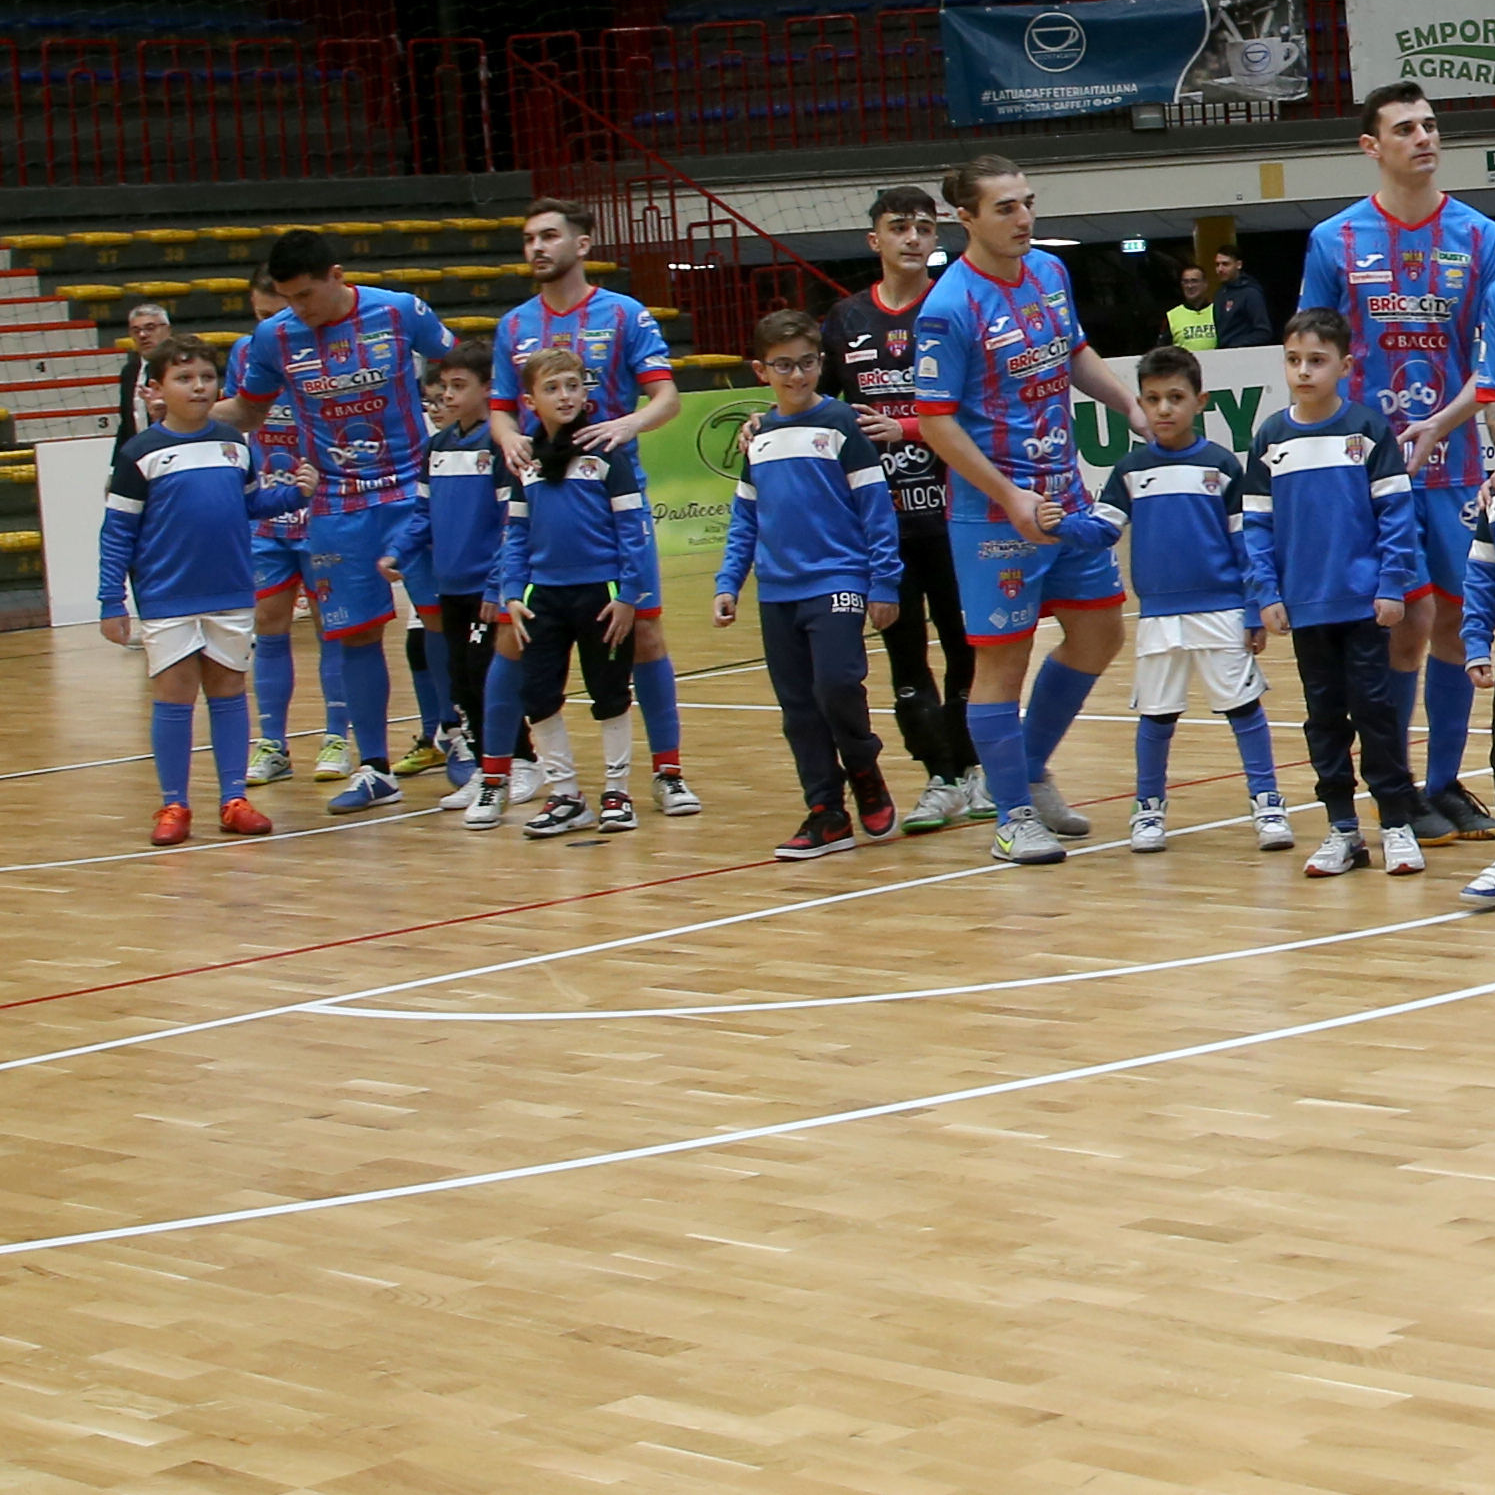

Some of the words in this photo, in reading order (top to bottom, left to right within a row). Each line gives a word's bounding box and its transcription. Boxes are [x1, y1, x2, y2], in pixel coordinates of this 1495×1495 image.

[981, 83, 1138, 103] #LATUACAFFETERIAITALIANA
[1183, 324, 1215, 336] STAFF
[35, 362, 45, 372] 4
[334, 399, 384, 418] BACCO
[98, 417, 109, 428] 3
[831, 592, 864, 608] 1981
